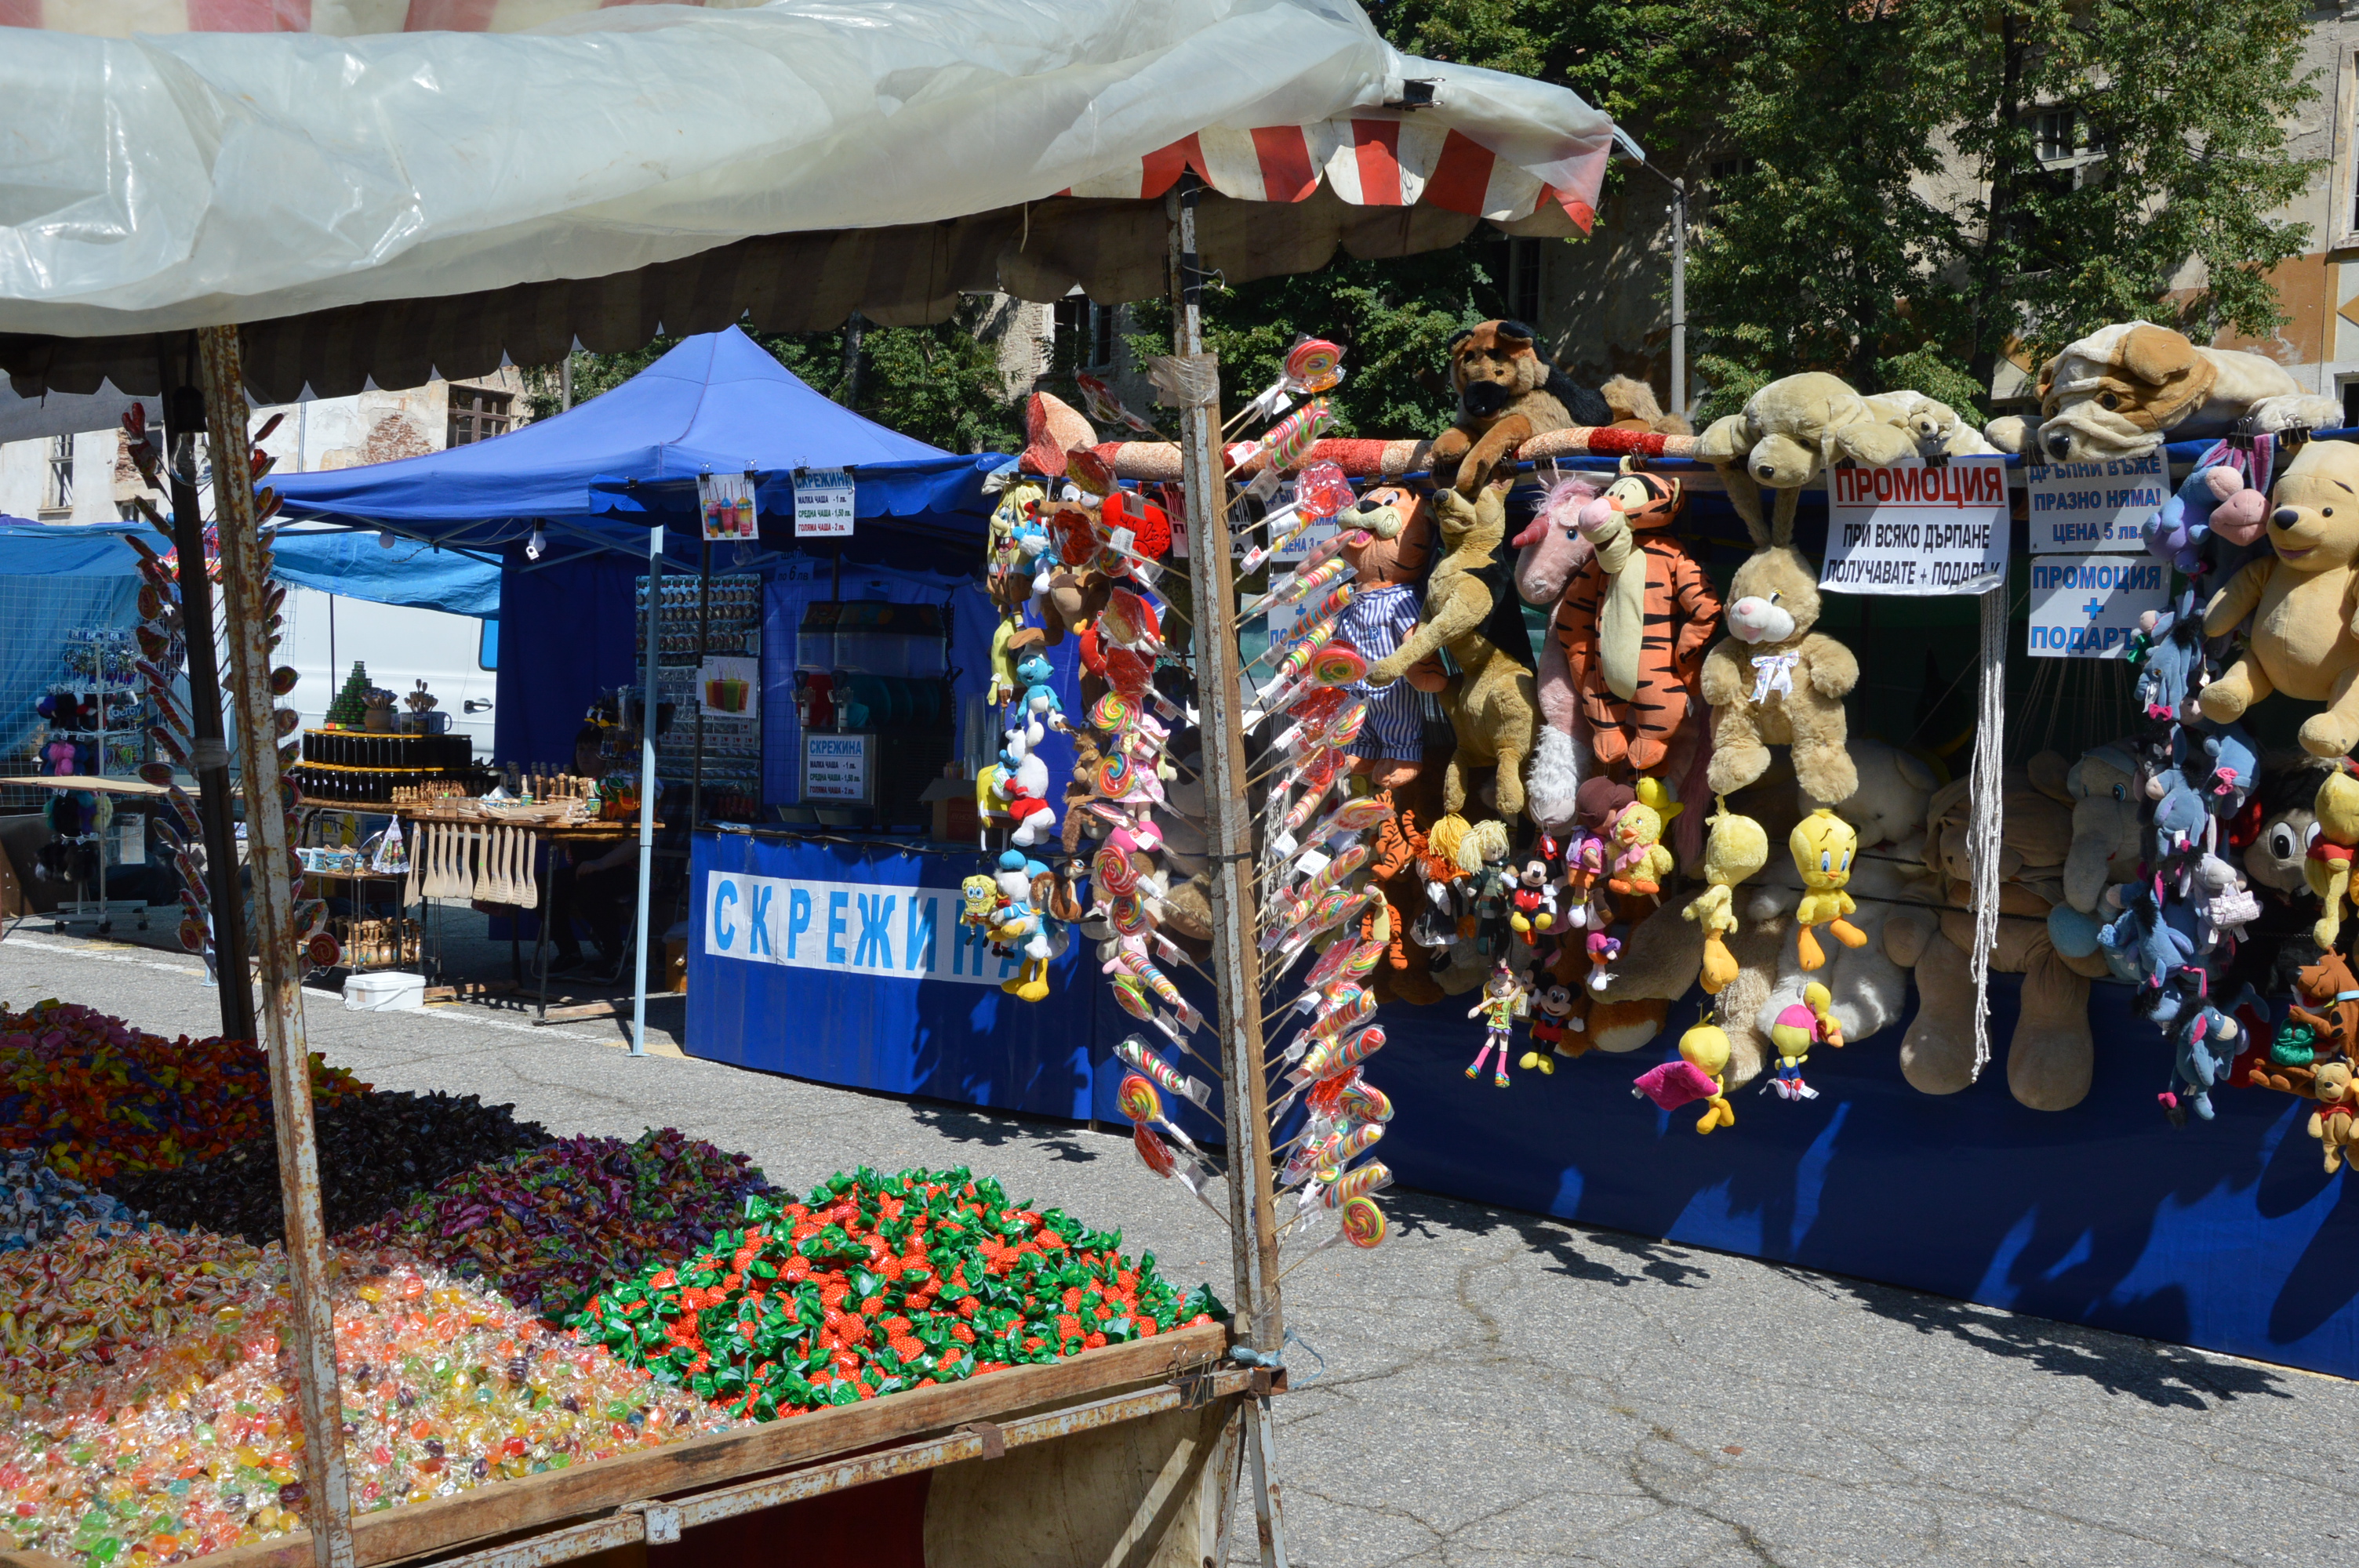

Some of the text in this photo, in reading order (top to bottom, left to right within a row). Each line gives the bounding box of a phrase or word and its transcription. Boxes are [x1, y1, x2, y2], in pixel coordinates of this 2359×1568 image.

[794, 472, 852, 488] СКРЕЖИНА
[2029, 456, 2161, 483] ДРЪПНИ ВЪЖЕ
[1835, 466, 2004, 509] ПРОМОЦИЯ
[815, 495, 829, 504] ЧАША
[2034, 488, 2161, 511] ПРАЗНО НЯМА!
[817, 509, 831, 517] ЧАША
[834, 509, 844, 518] 1,50
[818, 523, 831, 532] ЧАША
[834, 523, 838, 532] 2
[2052, 522, 2143, 544] ЦЕНА 5 лв.
[1842, 524, 1990, 554] ПРИ ВСЯКО ДЪРПАНЕ
[789, 564, 797, 580] 6
[1826, 559, 1917, 585] ПОЛУЧАВАТЕ
[2033, 565, 2161, 594] ПРОМОЦИЯ
[809, 739, 862, 755] СКРЕЖИНА
